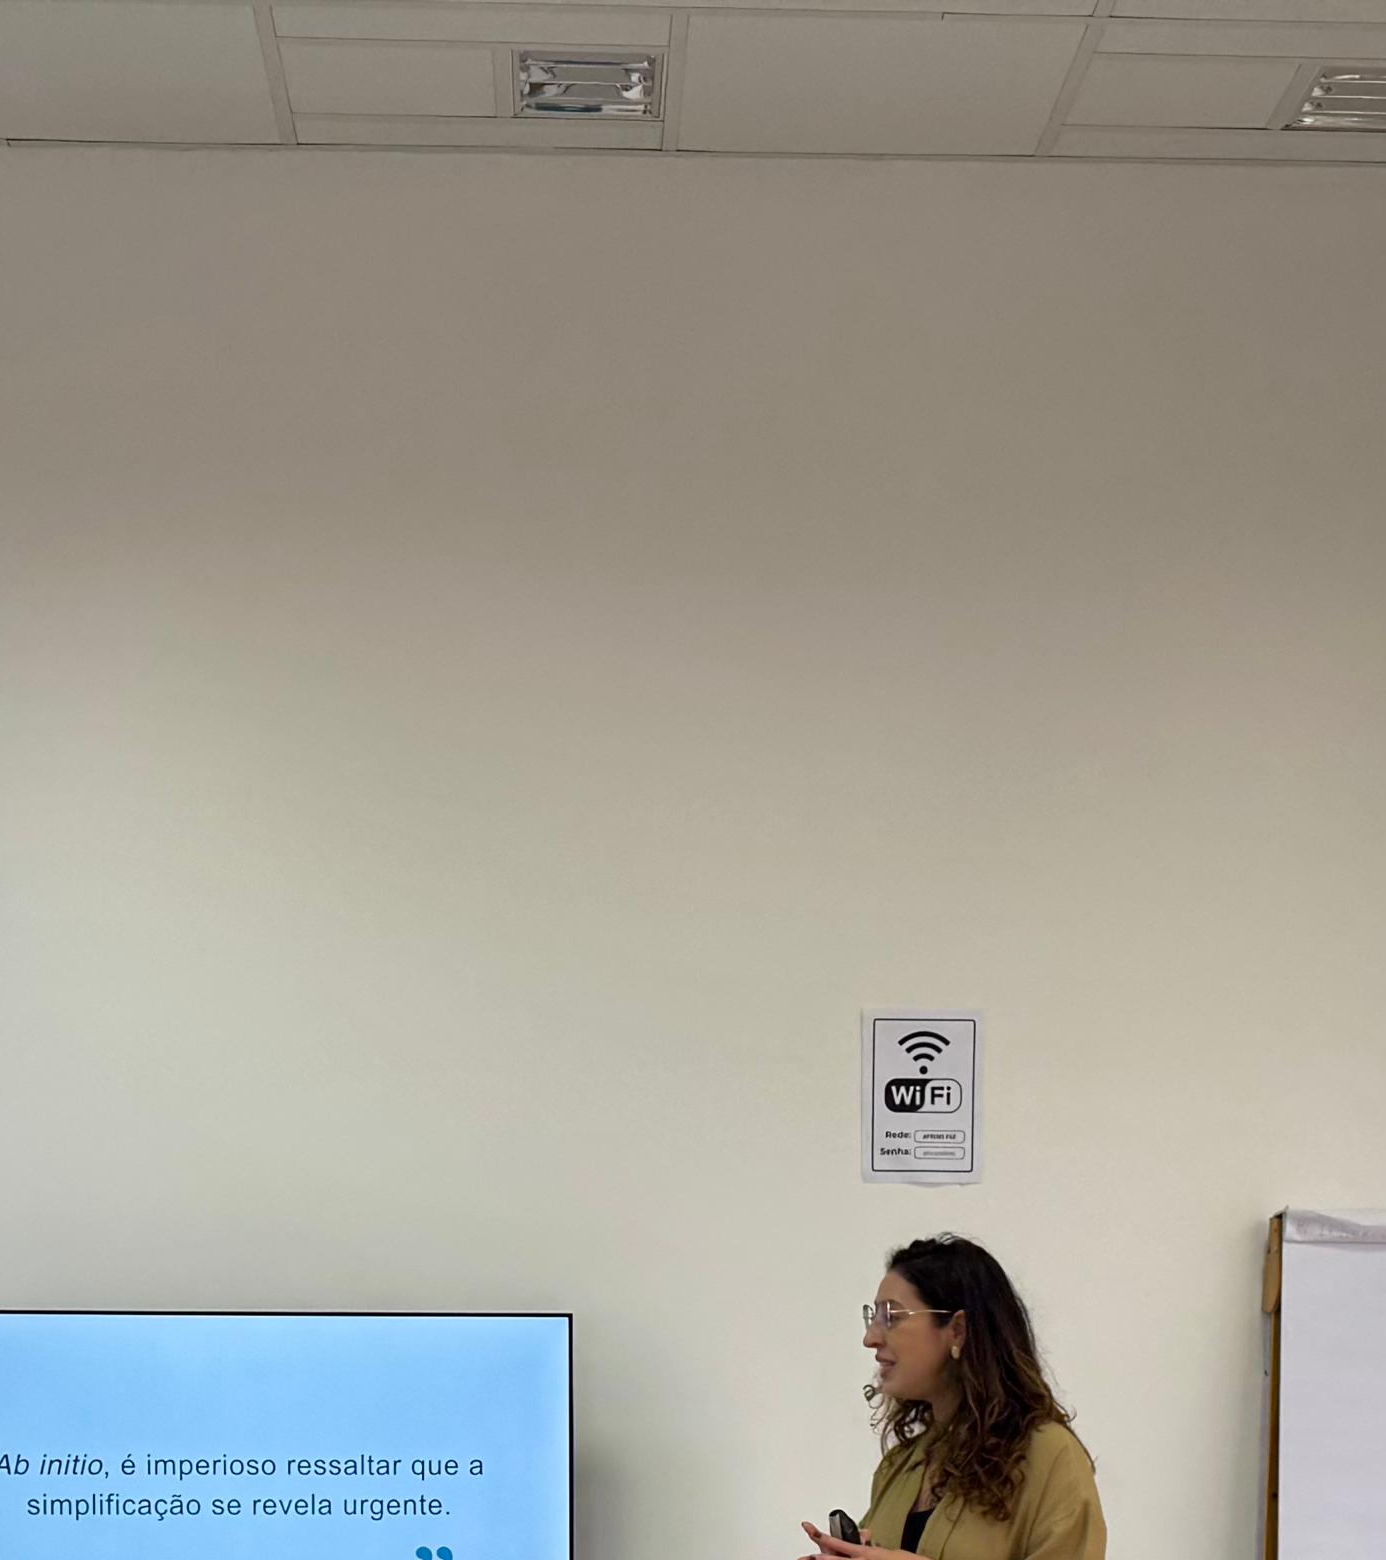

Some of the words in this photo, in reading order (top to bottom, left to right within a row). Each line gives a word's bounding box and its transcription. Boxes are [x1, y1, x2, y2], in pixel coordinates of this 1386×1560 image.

[885, 1131, 912, 1139] Rede:
[880, 1147, 912, 1156] Senha:
[39, 1453, 110, 1479] initio,
[121, 1453, 136, 1476] é
[147, 1454, 277, 1481] imperioso
[287, 1454, 402, 1476] ressaltar
[411, 1458, 459, 1481] que
[469, 1458, 484, 1476] a
[27, 1493, 202, 1521] simplificação
[211, 1498, 242, 1516] se
[252, 1494, 332, 1516] revela
[343, 1494, 451, 1521] urgente.
